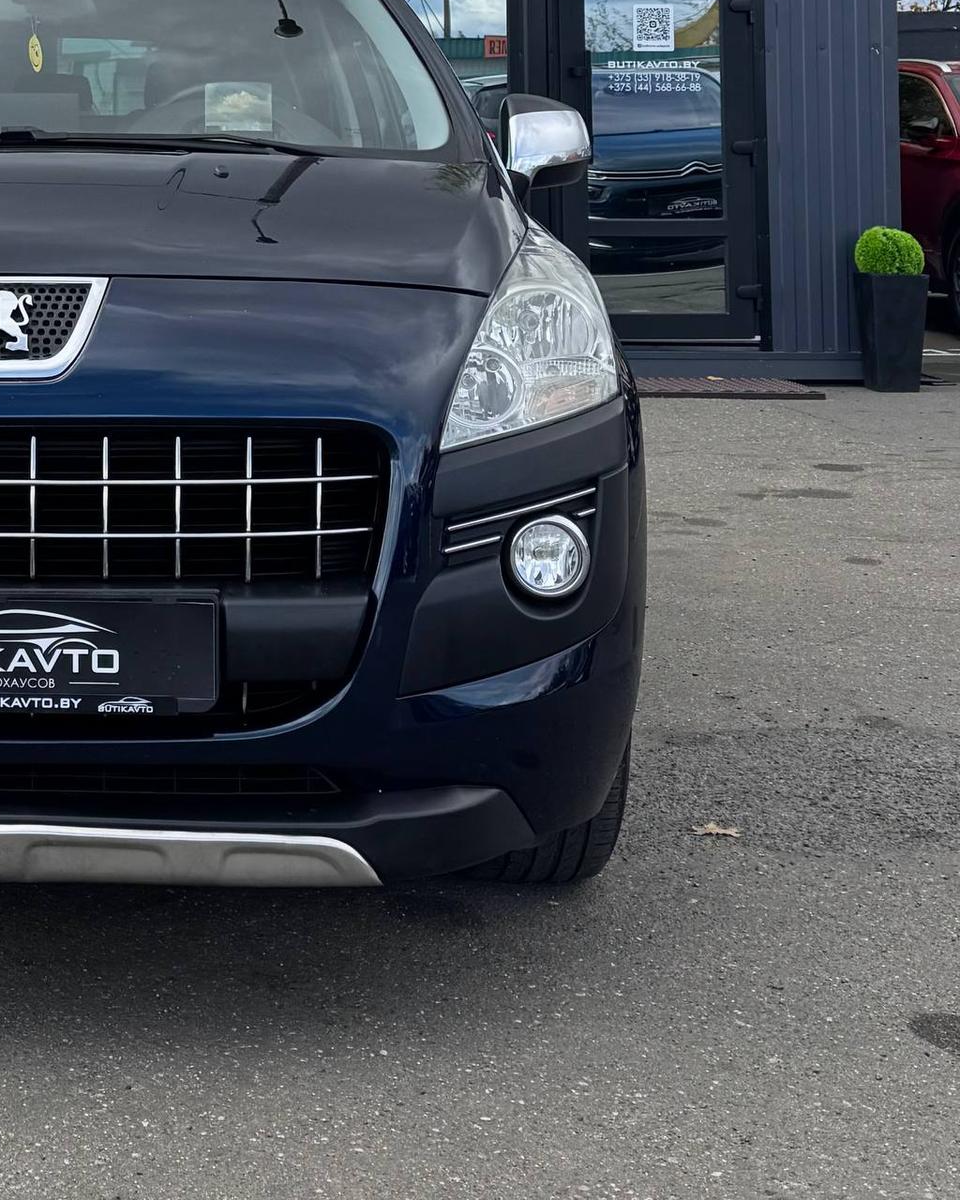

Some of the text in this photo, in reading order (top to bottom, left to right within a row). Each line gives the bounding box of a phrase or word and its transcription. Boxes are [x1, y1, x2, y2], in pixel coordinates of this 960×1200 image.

[607, 60, 700, 69] BUTIKAVTO.BY
[608, 72, 701, 84] +375 (33) 918-38-19
[608, 82, 702, 94] +375 (44) 568-66-88
[97, 705, 154, 714] BUTIKAVTO
